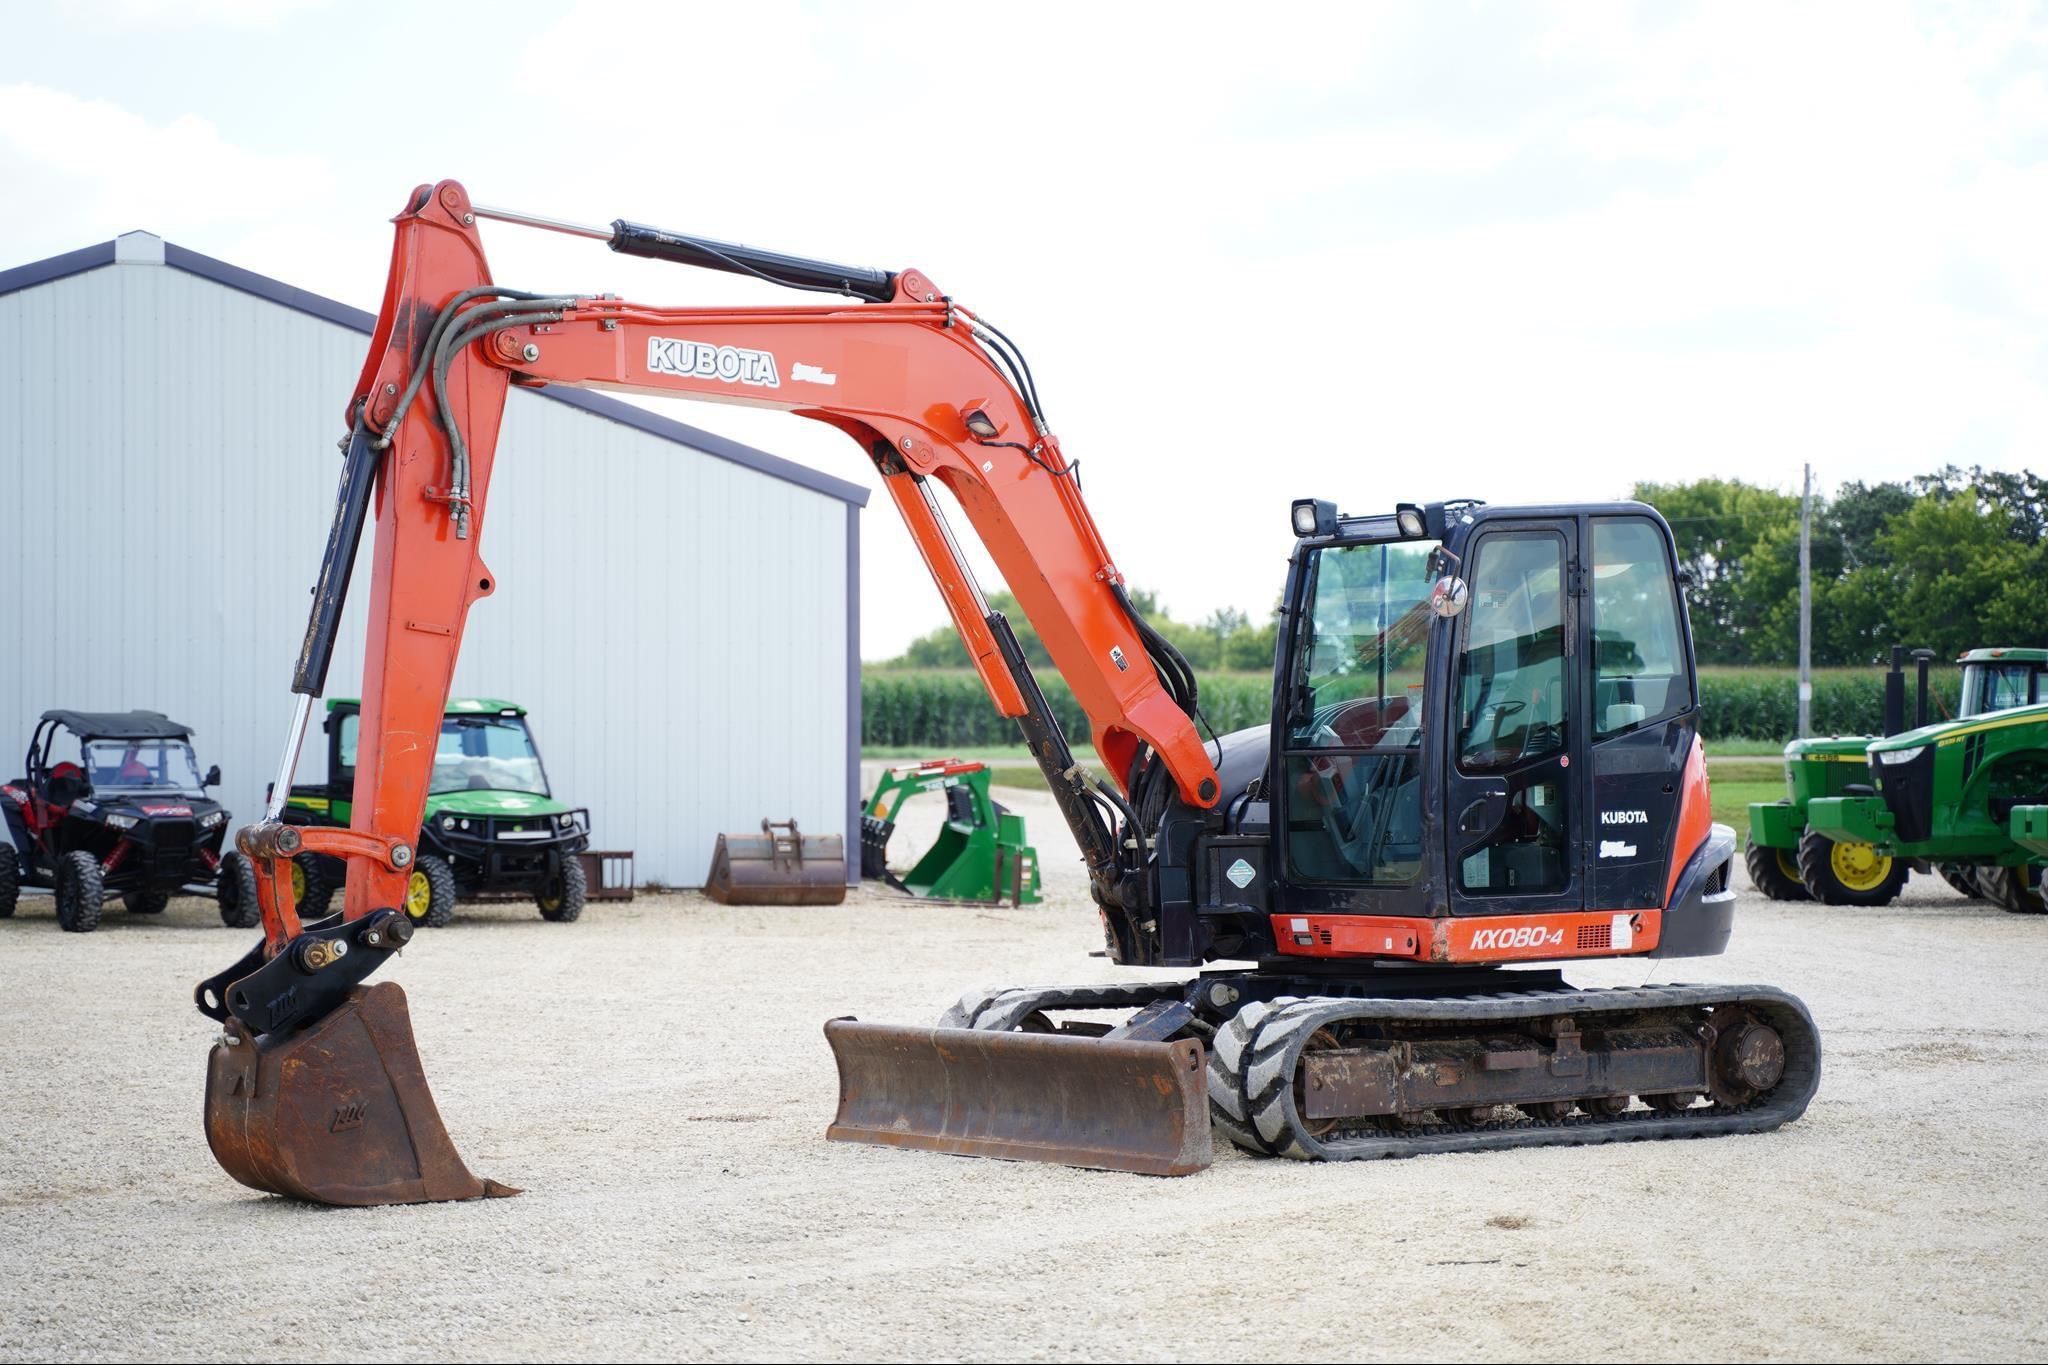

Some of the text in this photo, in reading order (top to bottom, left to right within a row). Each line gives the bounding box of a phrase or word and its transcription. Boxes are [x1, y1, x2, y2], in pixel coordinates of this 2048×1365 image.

[649, 338, 778, 386] KUBOTA
[1601, 811, 1648, 824] KUBOTA
[1470, 926, 1564, 950] KX080-4
